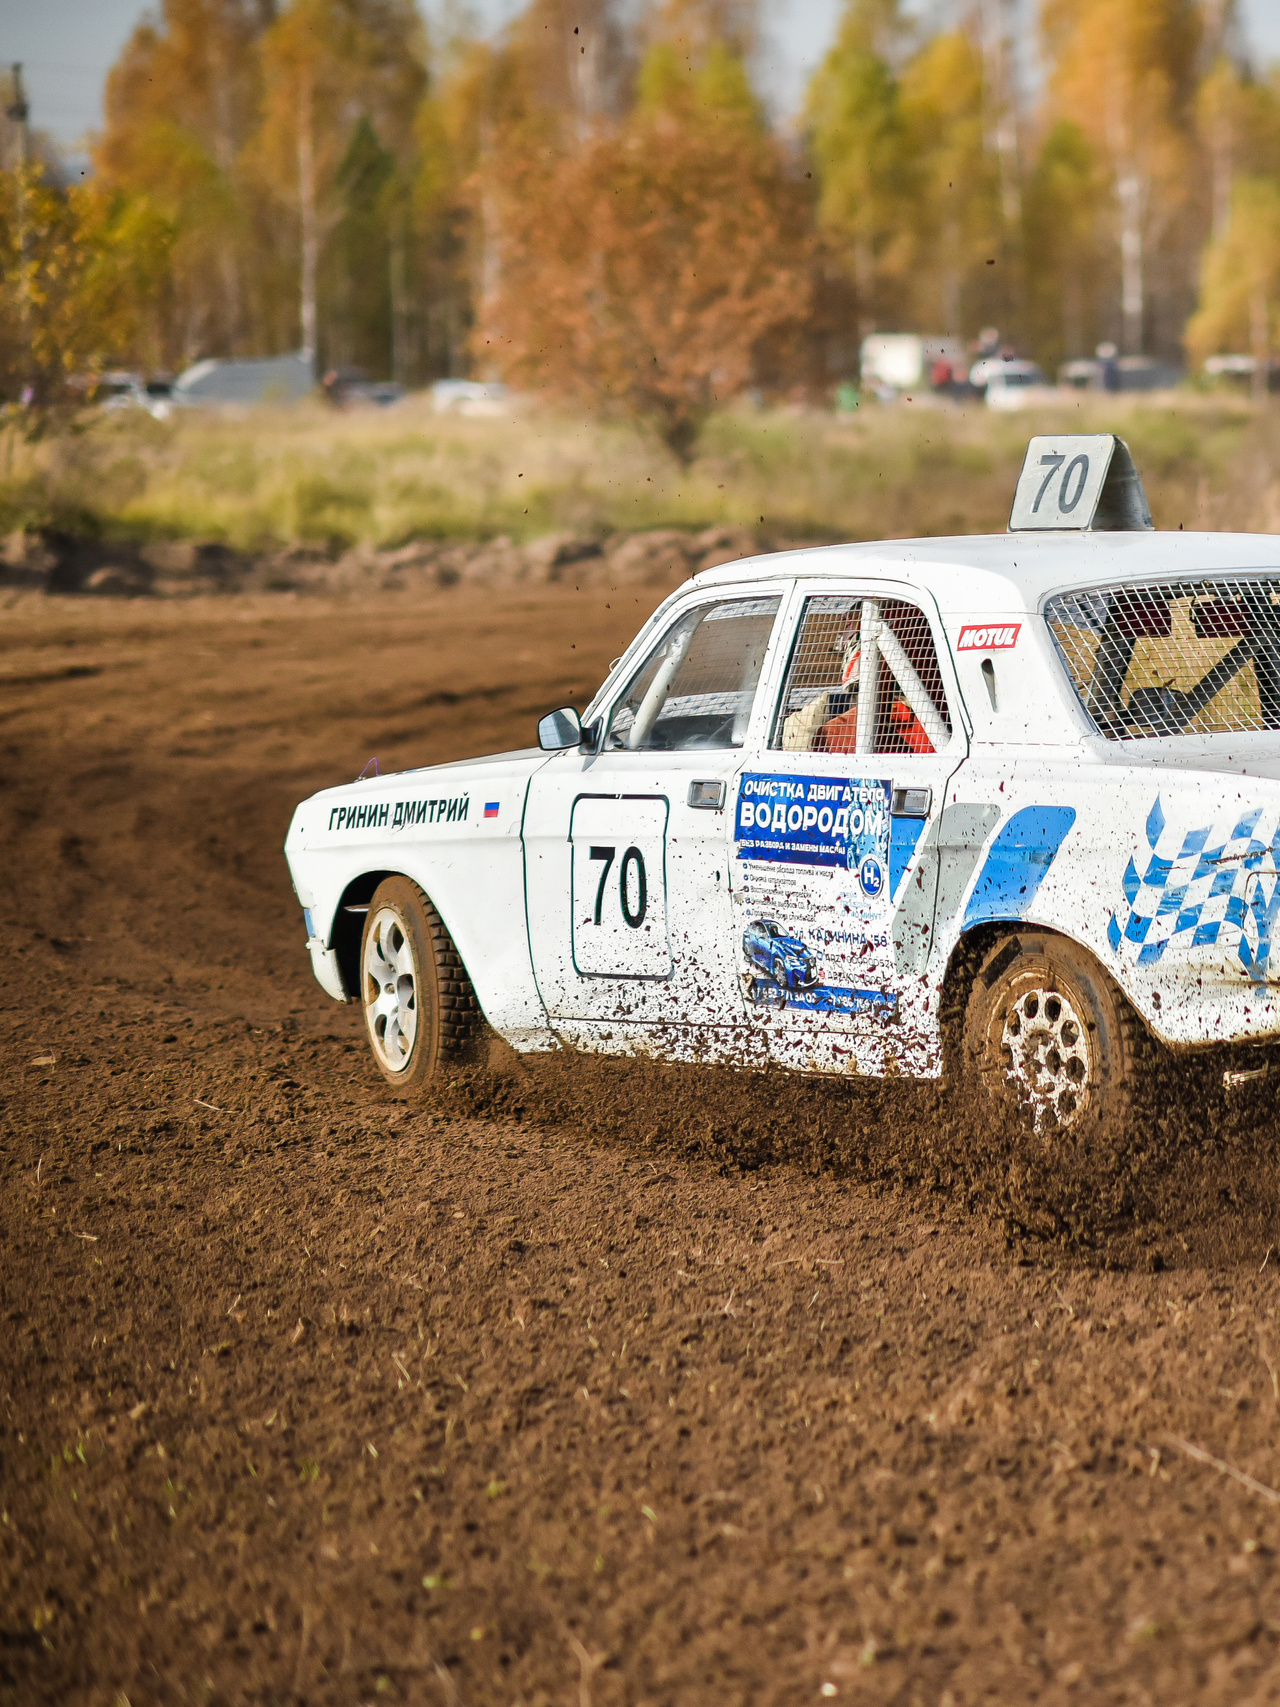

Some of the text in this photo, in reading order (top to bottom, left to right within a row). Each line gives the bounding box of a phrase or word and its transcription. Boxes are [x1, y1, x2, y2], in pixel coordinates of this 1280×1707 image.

[1031, 453, 1090, 514] 70
[958, 627, 1018, 648] MOTUL
[744, 780, 886, 802] ОЧИСТКА ДВИГАТЕЛЯ
[328, 791, 471, 831] ГРИНИН ДМИТРИЙ
[739, 801, 884, 839] ВОДОРОДОМ
[588, 845, 647, 929] 70
[873, 934, 888, 948] 58
